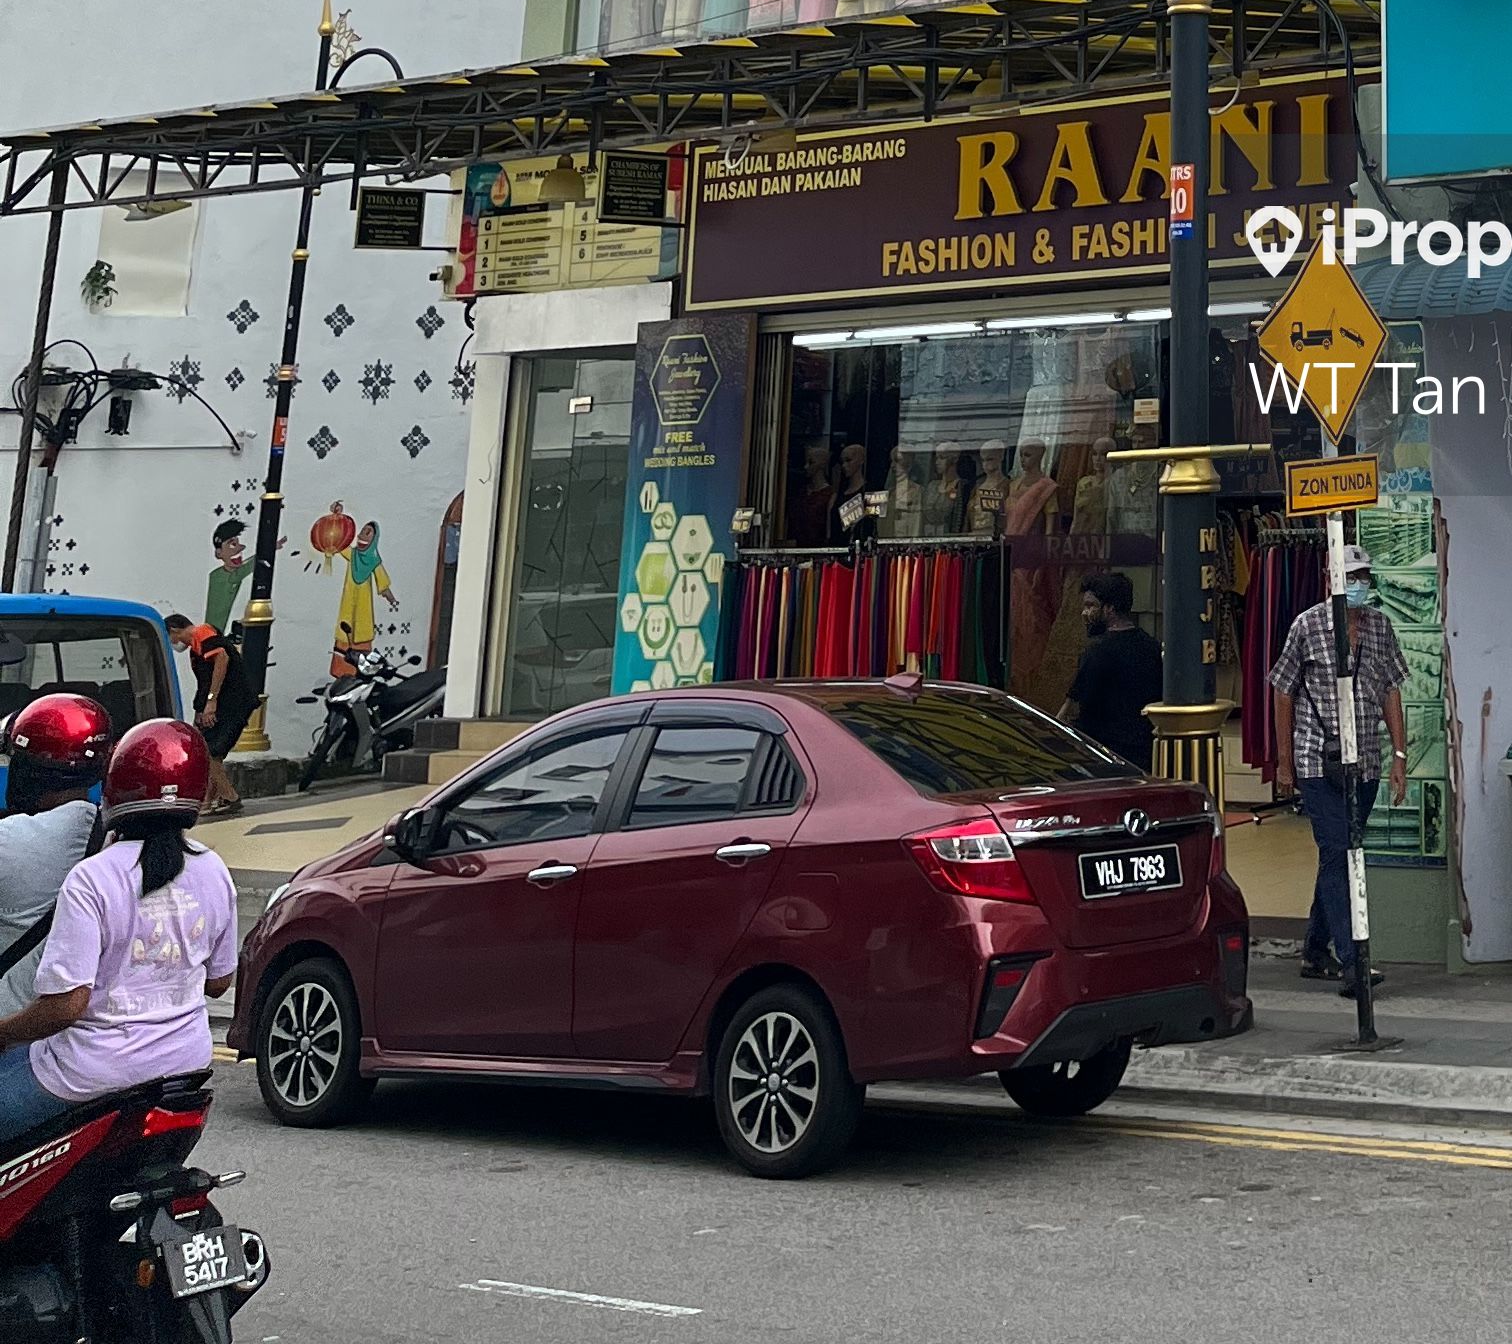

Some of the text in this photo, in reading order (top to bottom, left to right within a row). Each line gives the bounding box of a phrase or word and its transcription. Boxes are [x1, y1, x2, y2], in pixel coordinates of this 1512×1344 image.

[704, 138, 907, 180] MENJUAL BARANG-BARANG
[953, 93, 1335, 221] RAANI
[702, 166, 861, 203] HIASAN DAN PAKAIAN
[882, 232, 1016, 277] FASHION
[1032, 228, 1056, 263] &
[1071, 212, 1216, 261] FASHI
[665, 431, 693, 443] FREE
[677, 454, 715, 466] BANGLES
[1300, 473, 1373, 497] ZON TUNDA
[1095, 854, 1166, 886] VHJ 7963
[182, 1234, 224, 1264] BRH
[184, 1256, 228, 1286] 5417
